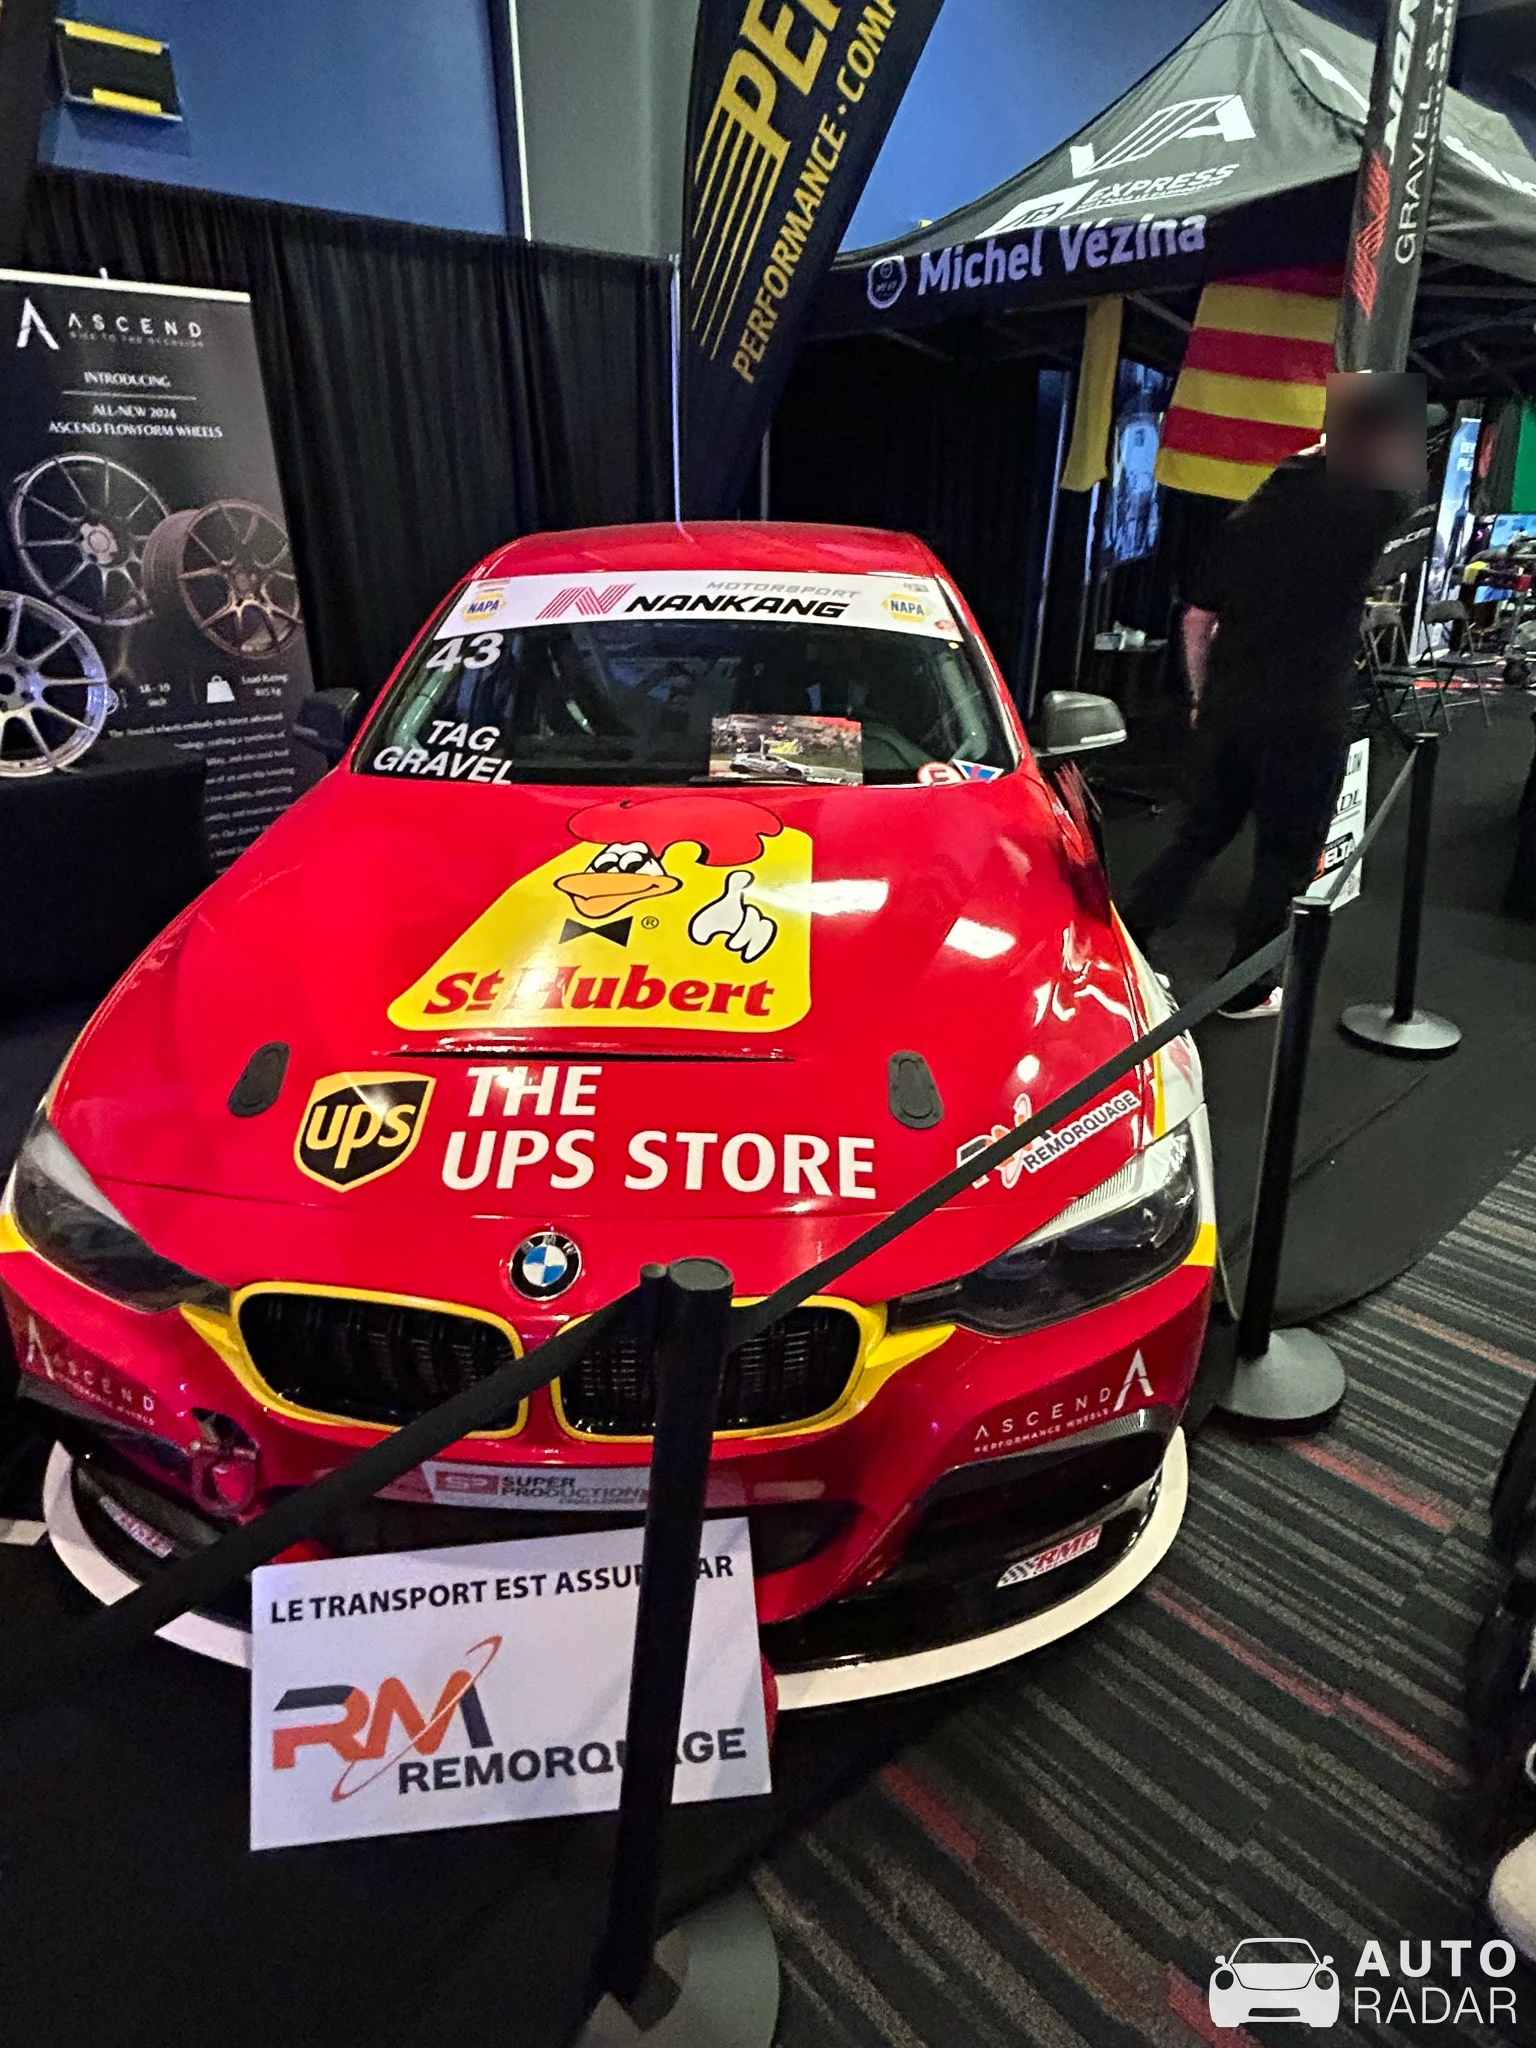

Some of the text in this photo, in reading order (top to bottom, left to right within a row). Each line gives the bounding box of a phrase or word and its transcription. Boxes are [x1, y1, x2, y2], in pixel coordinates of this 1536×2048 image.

[1083, 163, 1240, 205] EXPRESS
[1395, 84, 1433, 264] GRAVEL
[732, 114, 848, 382] PERFORMANCE
[917, 227, 1043, 296] Michel
[1059, 213, 1208, 273] Vézina
[68, 312, 202, 338] ASCEND
[84, 371, 171, 388] INTRODUCING
[49, 421, 102, 434] ASCEND
[175, 424, 223, 438] WHEELS
[467, 599, 500, 614] NAPA
[626, 594, 850, 619] NANKANG
[706, 582, 861, 598] MOTORSPORT
[890, 600, 925, 615] NAPA
[426, 632, 504, 673] 43
[427, 719, 501, 752] TAG
[373, 745, 514, 785] GRAVEL
[422, 968, 504, 1014] St
[466, 1065, 602, 1117] THE
[305, 1104, 417, 1169] ups
[1022, 1092, 1139, 1171] REMORQUAGE
[441, 1128, 876, 1200] UPS STORE
[974, 1387, 1112, 1440] ASCEND
[502, 1475, 577, 1489] SUPER
[270, 1555, 734, 1625] LE TRANSPORT EST ASSU AR
[399, 1727, 748, 1795] REMORQGE
